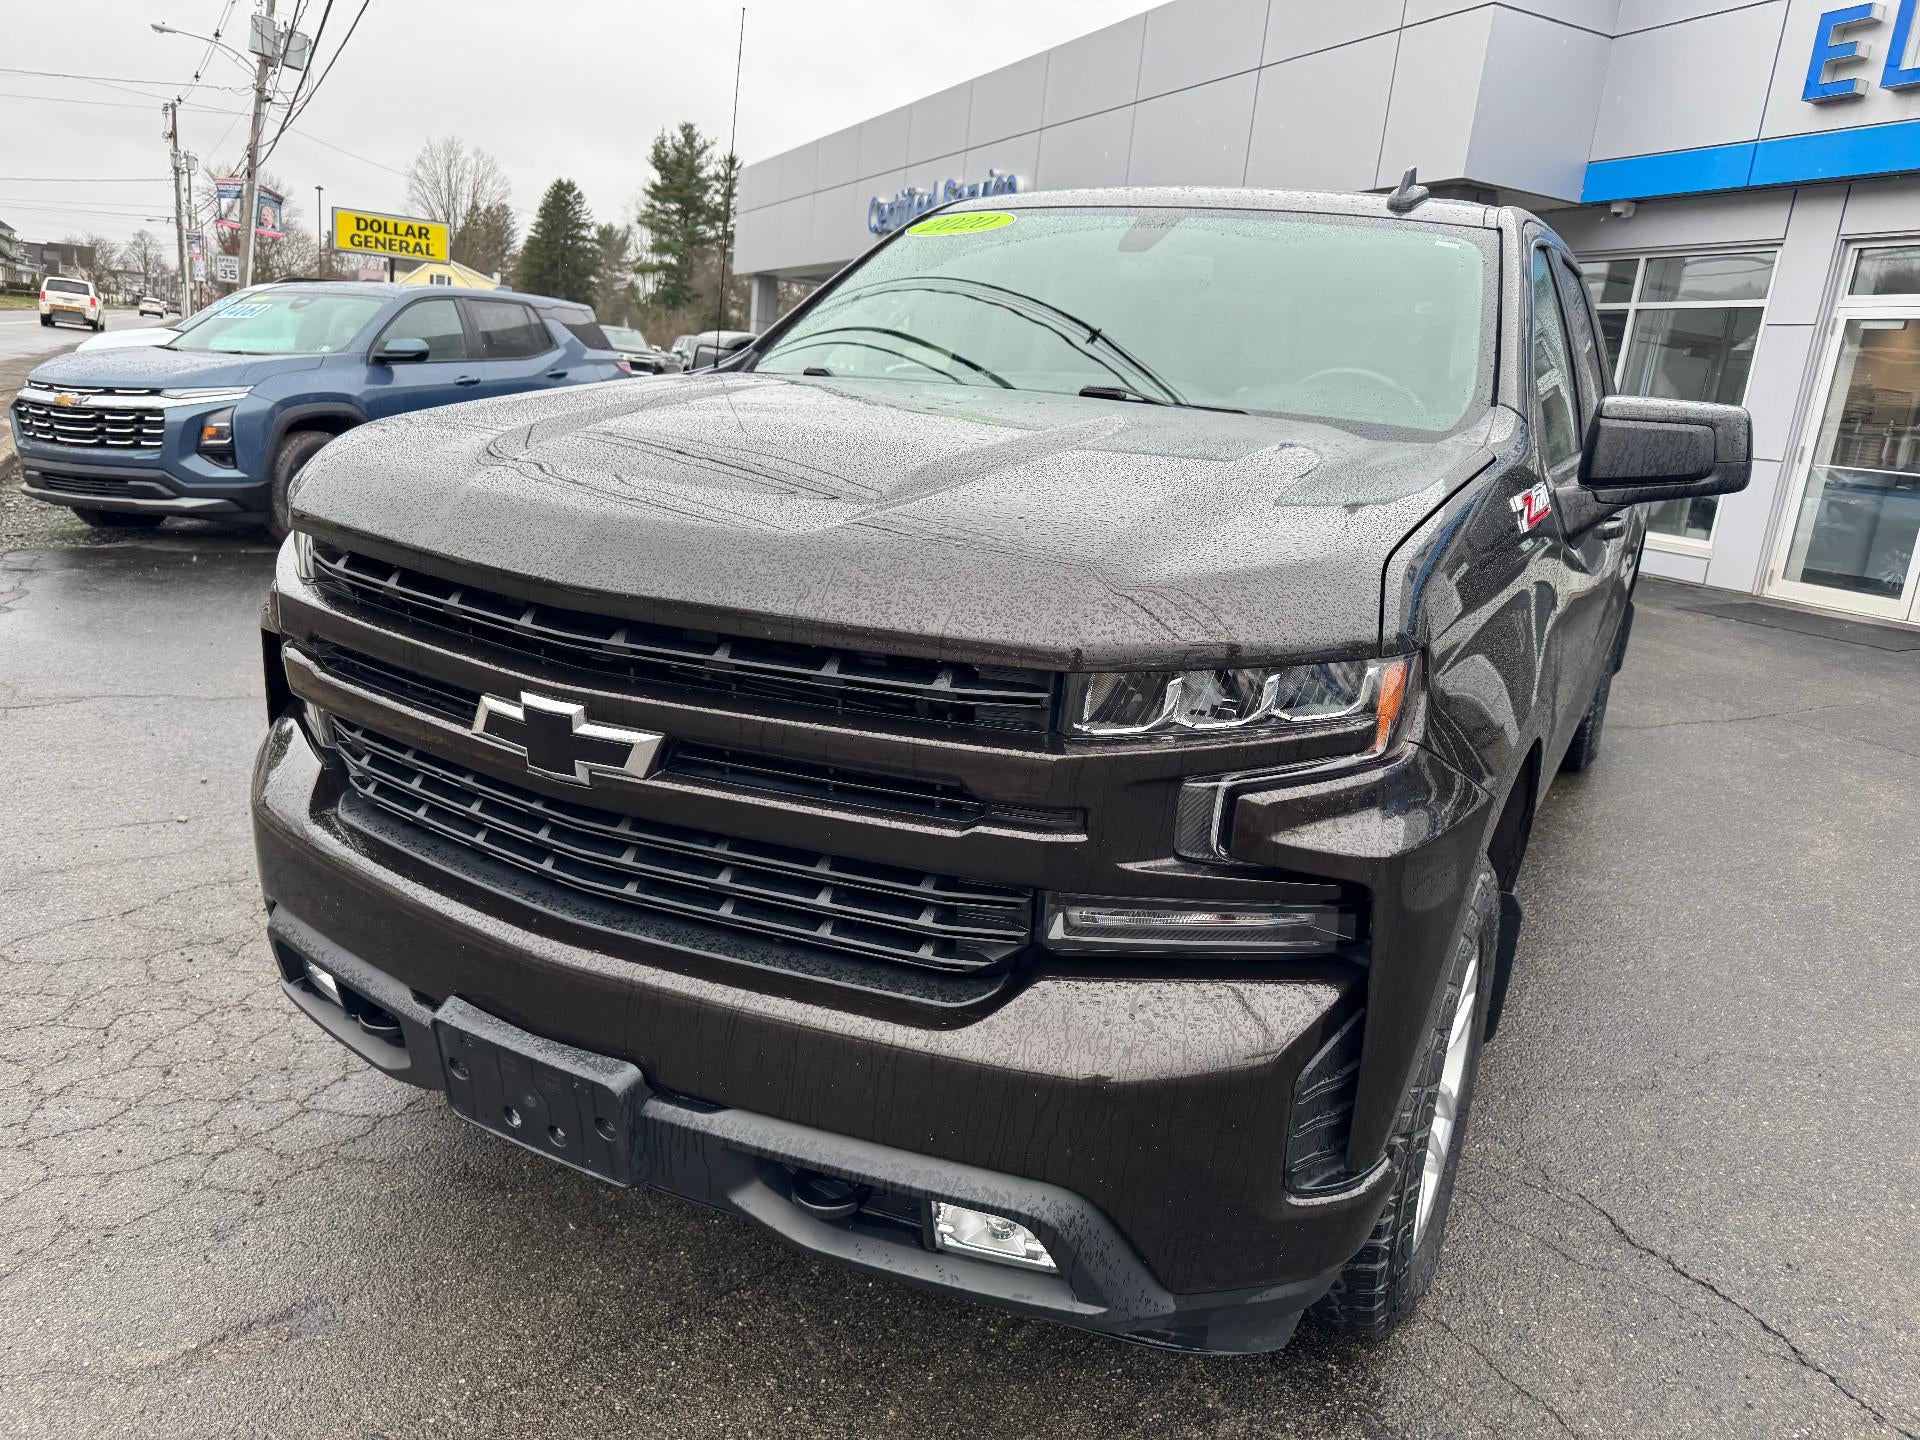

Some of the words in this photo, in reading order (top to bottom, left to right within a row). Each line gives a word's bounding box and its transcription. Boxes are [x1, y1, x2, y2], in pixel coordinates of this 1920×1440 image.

[355, 217, 430, 240] DOLLAR
[350, 233, 436, 257] GENERAL
[220, 269, 237, 280] 35
